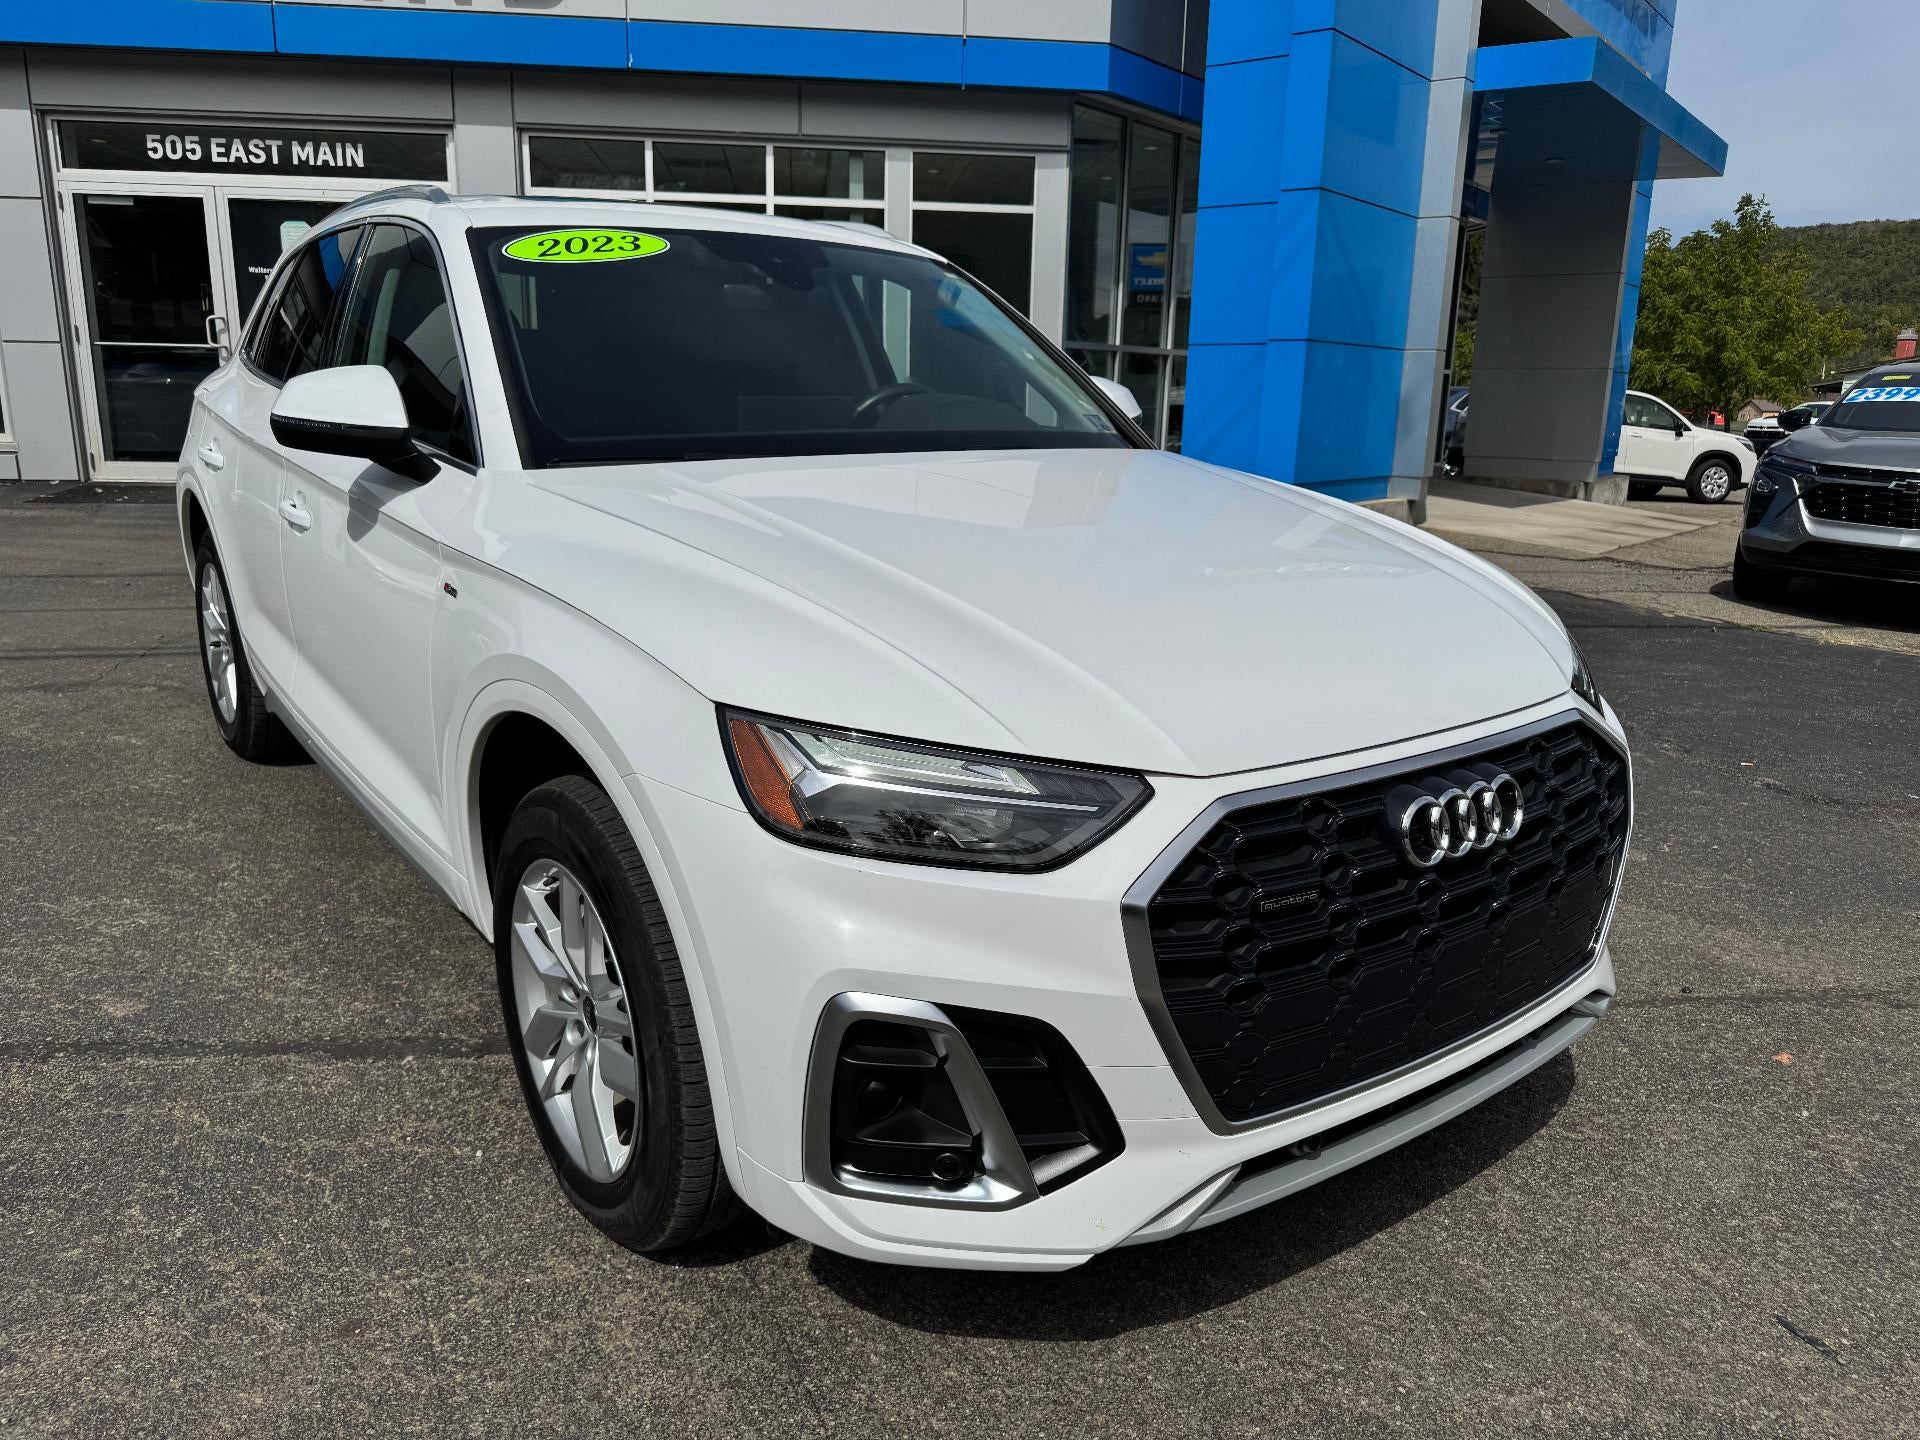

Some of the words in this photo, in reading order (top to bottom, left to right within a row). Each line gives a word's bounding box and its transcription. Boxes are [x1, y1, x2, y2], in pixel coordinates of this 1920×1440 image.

[146, 134, 201, 161] 505
[210, 137, 283, 165] EAST
[291, 140, 365, 168] MAIN
[537, 235, 642, 258] 2023
[1263, 892, 1318, 910] quattro
